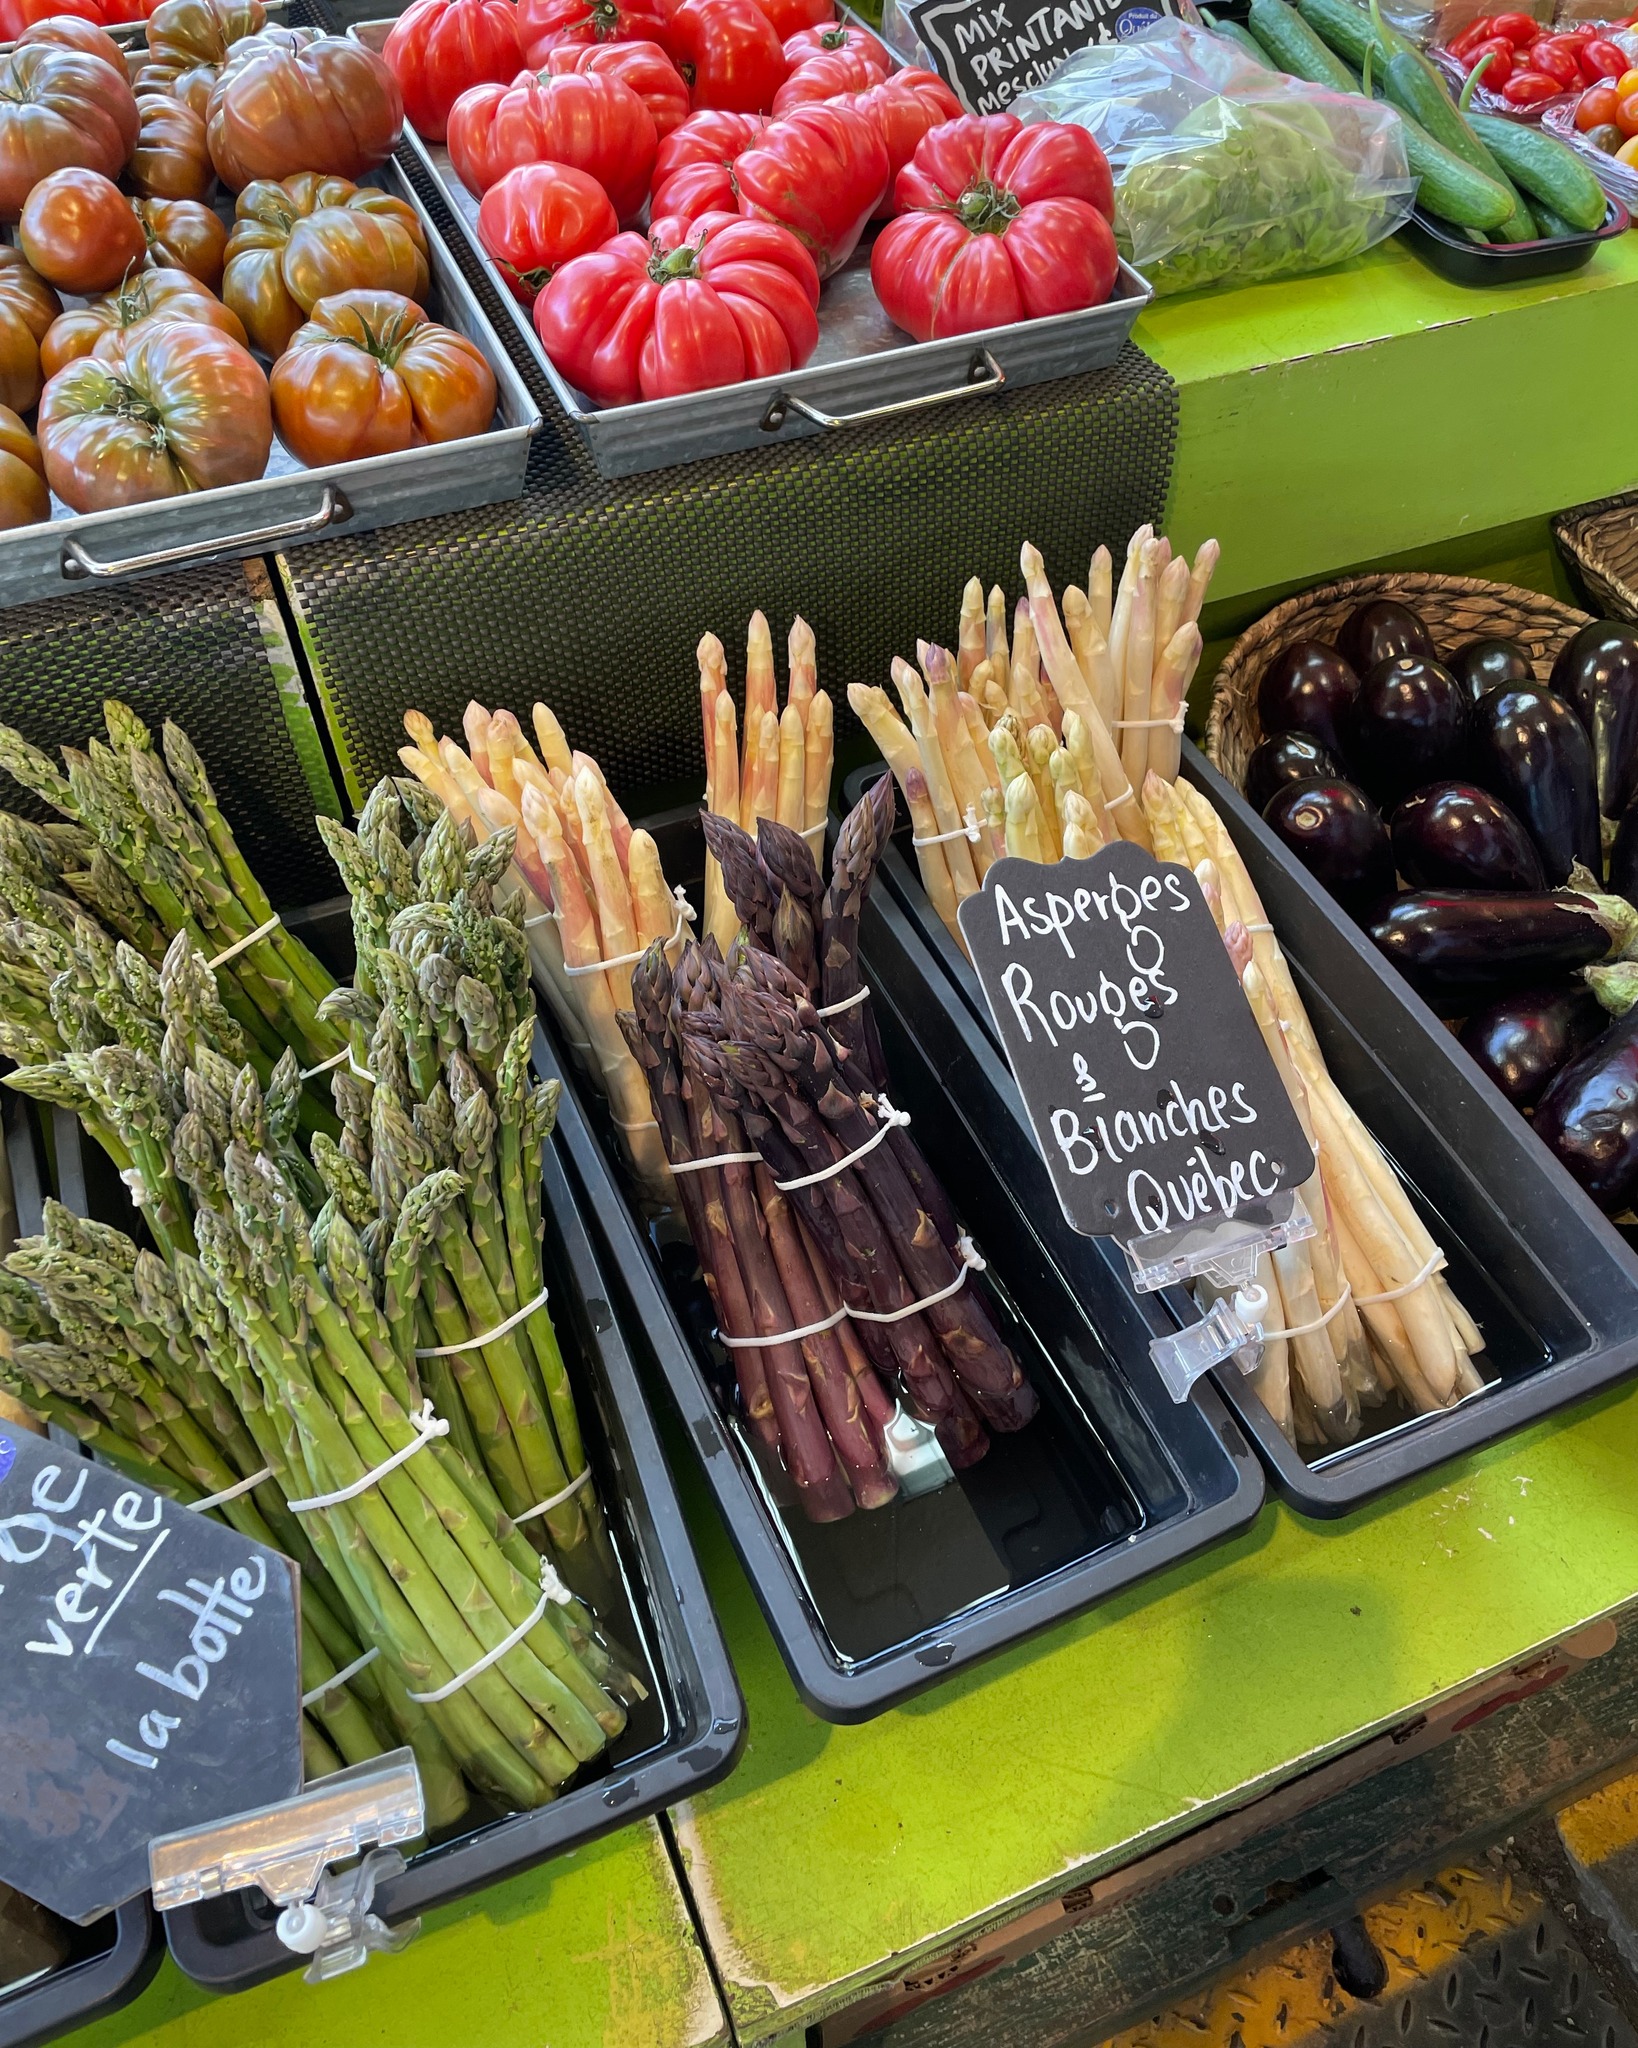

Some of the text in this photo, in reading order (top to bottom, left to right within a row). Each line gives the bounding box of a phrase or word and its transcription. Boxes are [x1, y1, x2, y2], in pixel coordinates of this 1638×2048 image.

[1128, 12, 1149, 20] Produit
[995, 871, 1191, 976] Asperges
[1001, 962, 1178, 1070] Rouges
[1052, 1080, 1258, 1175] Blanches
[1127, 1146, 1279, 1234] Québec
[25, 1490, 163, 1656] verte
[105, 1555, 267, 1770] la botte
